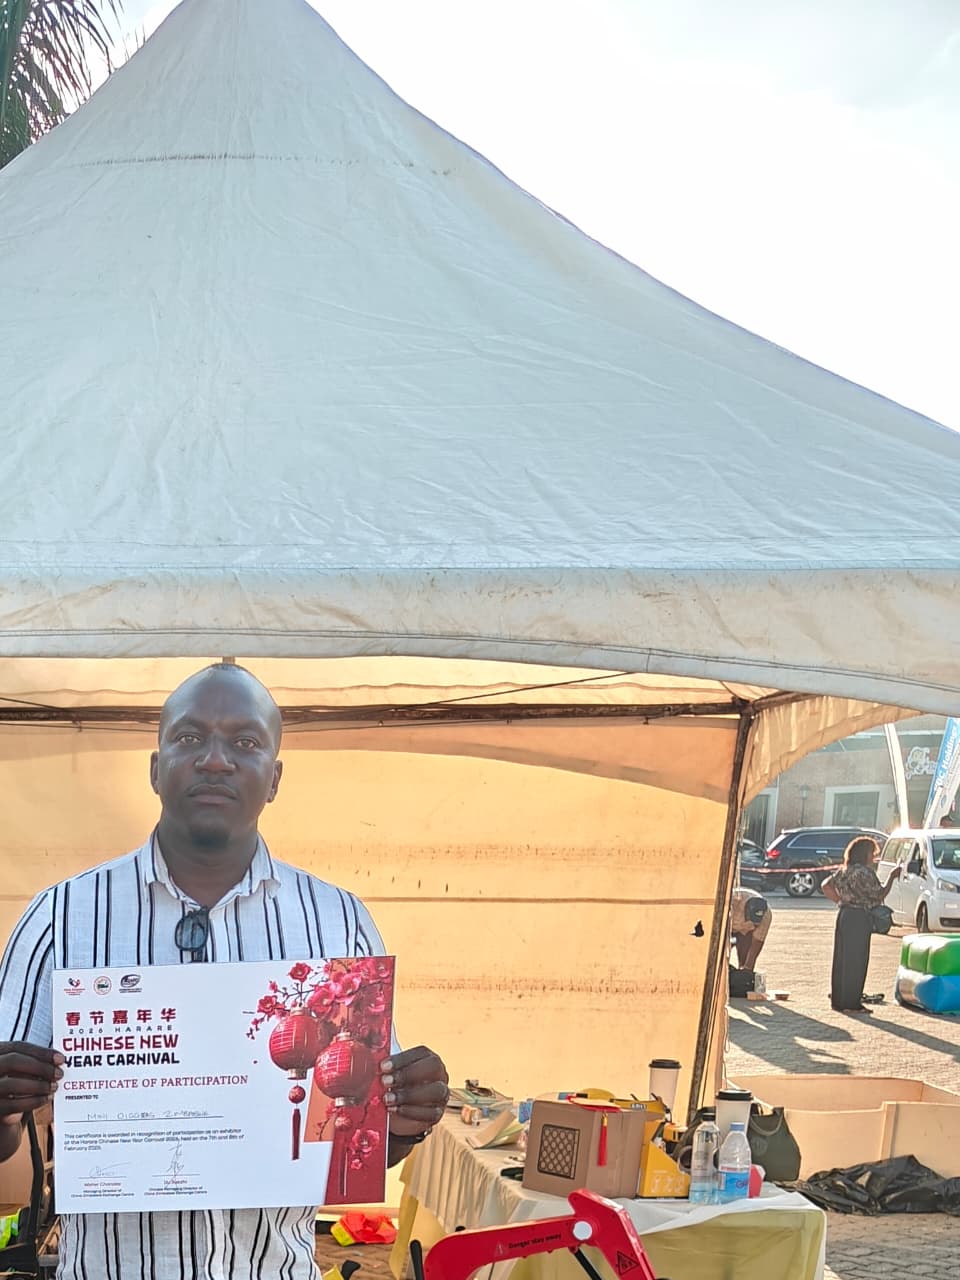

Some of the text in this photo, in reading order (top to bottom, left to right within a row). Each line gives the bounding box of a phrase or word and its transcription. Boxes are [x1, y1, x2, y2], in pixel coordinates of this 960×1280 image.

[66, 1008, 176, 1026] 春节嘉年华
[63, 1034, 178, 1051] CHINESE NEW
[64, 1052, 180, 1068] YEAR CARNIVAL
[63, 1075, 248, 1090] CERTIFICATE OF PARTICIPATION
